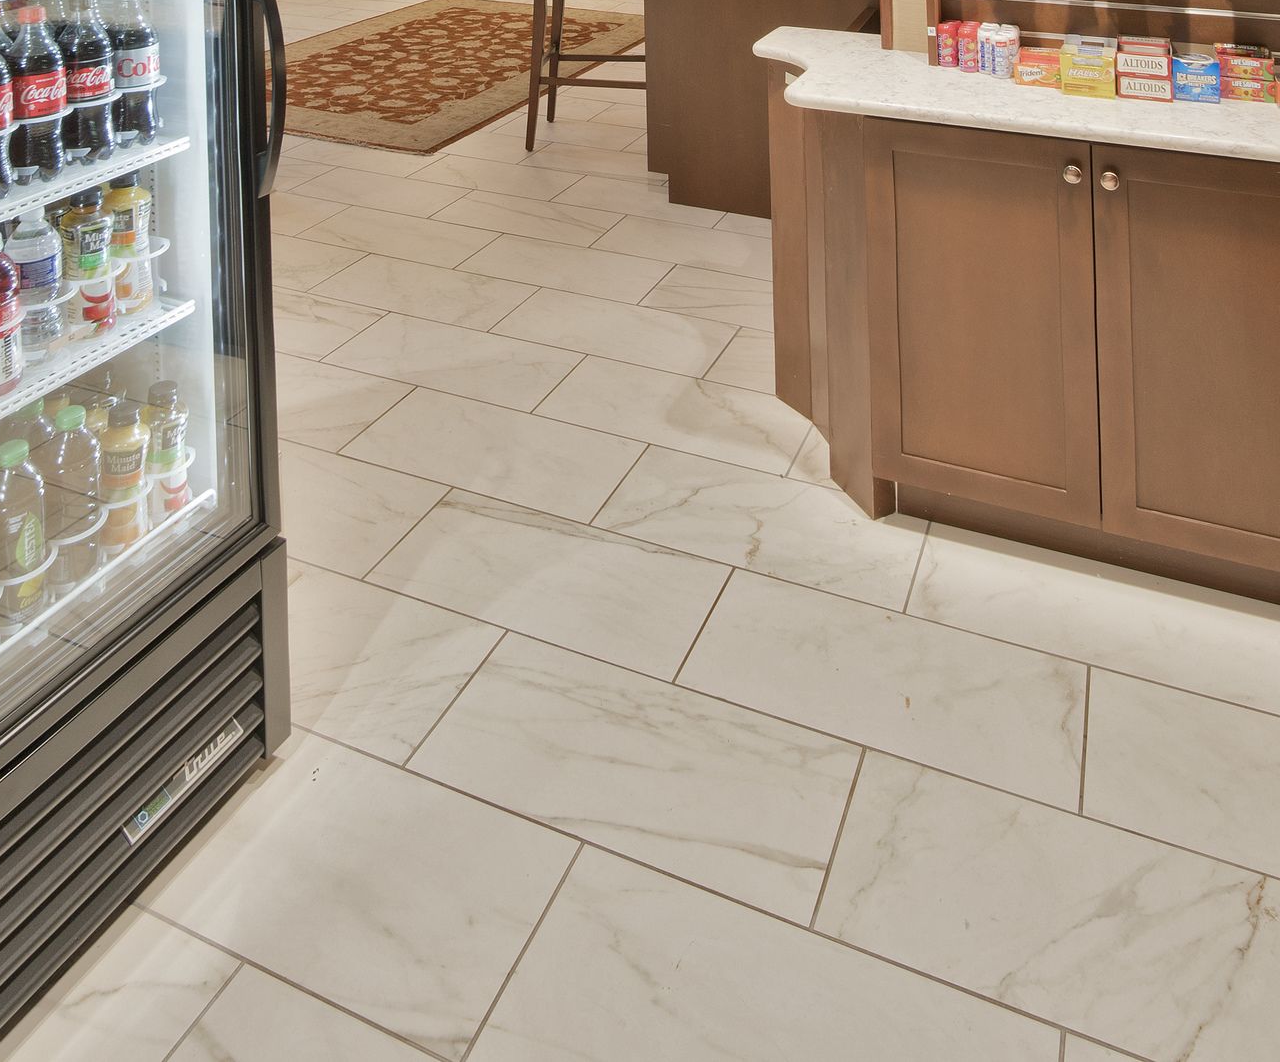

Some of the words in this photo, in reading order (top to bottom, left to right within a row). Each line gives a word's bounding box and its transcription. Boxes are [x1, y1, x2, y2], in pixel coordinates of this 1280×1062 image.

[1122, 57, 1163, 70] ALTOIDS
[1068, 68, 1100, 77] HALLS
[1188, 73, 1217, 85] BREAKERS
[1126, 81, 1167, 93] ALTOIDS
[106, 453, 140, 464] Minute
[111, 462, 135, 473] Maid
[25, 520, 37, 565] NESTEA
